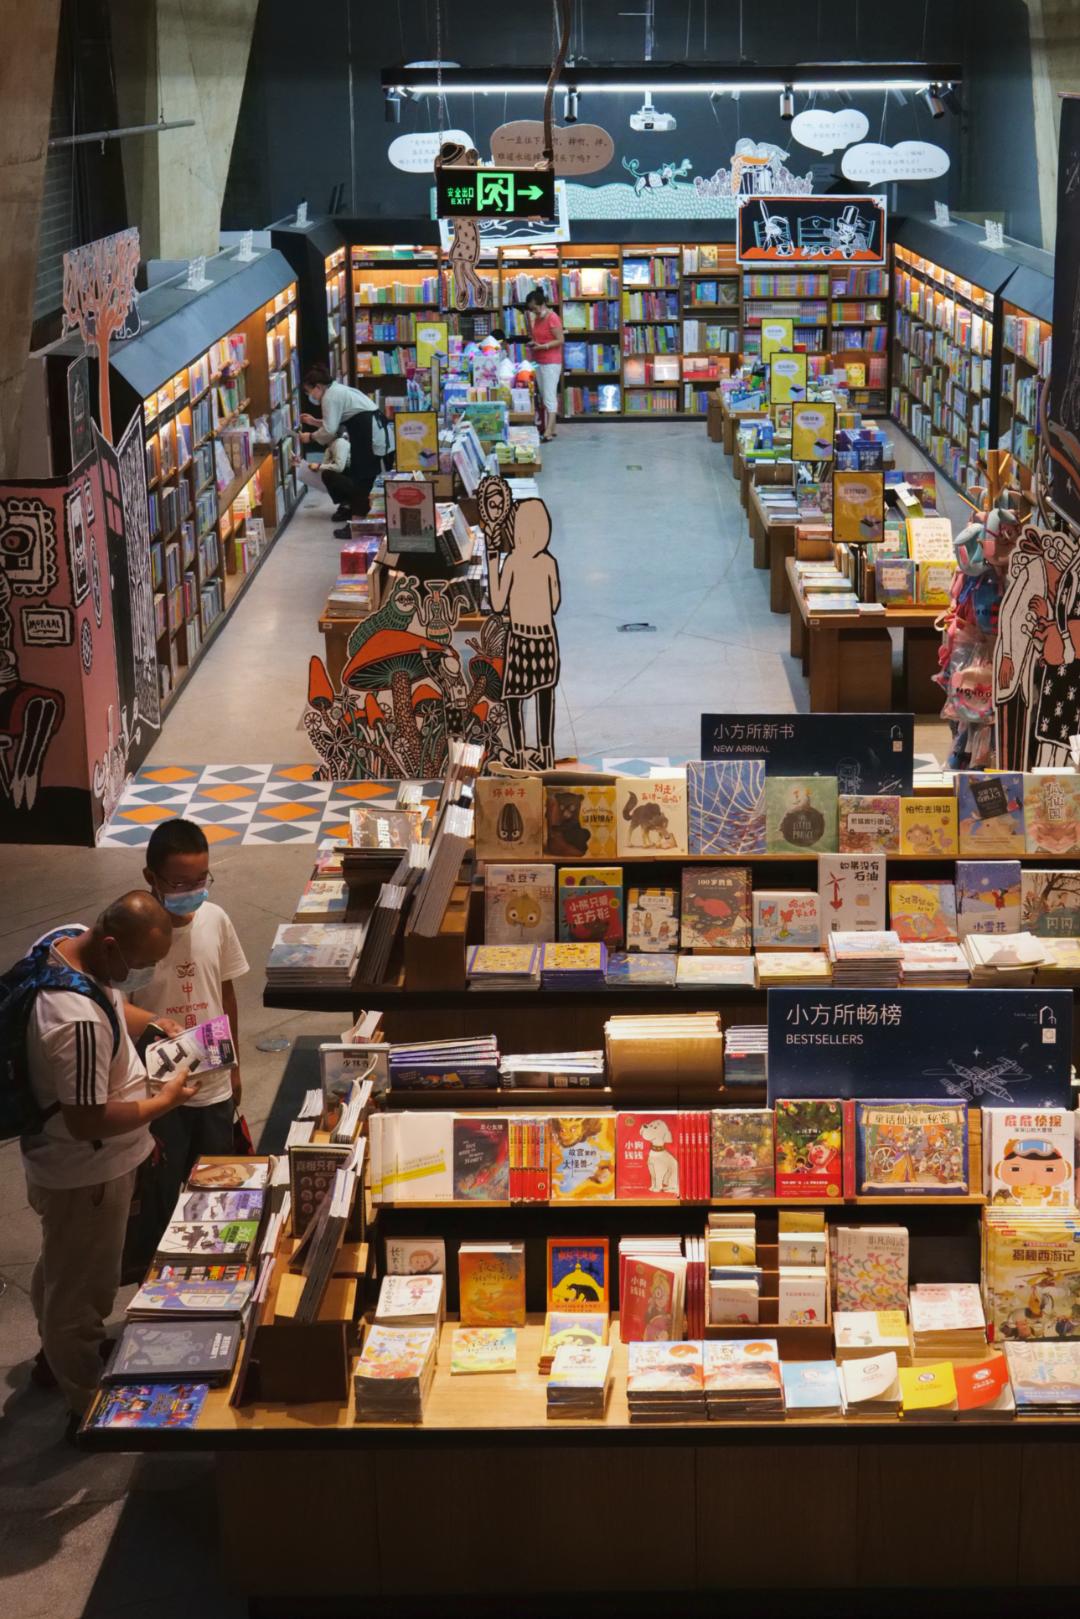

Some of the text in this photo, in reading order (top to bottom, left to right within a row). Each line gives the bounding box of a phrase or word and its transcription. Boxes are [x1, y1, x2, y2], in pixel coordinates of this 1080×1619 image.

[447, 187, 474, 198] 安全出口
[713, 723, 795, 740] 小方所新书
[713, 745, 770, 753] NEW ARRIVAL
[840, 860, 879, 871] 如果没有
[854, 871, 879, 882] 石油
[572, 907, 610, 926] 正方形
[973, 920, 1007, 933] 小雪花
[166, 1005, 185, 1014] MADE
[786, 1003, 902, 1026] 小方所畅榜
[785, 1033, 864, 1045] BESTSELLERS
[1004, 1115, 1063, 1127] 屁屁侦探
[625, 1141, 644, 1150] 小狗
[625, 1151, 644, 1160] 钱钱
